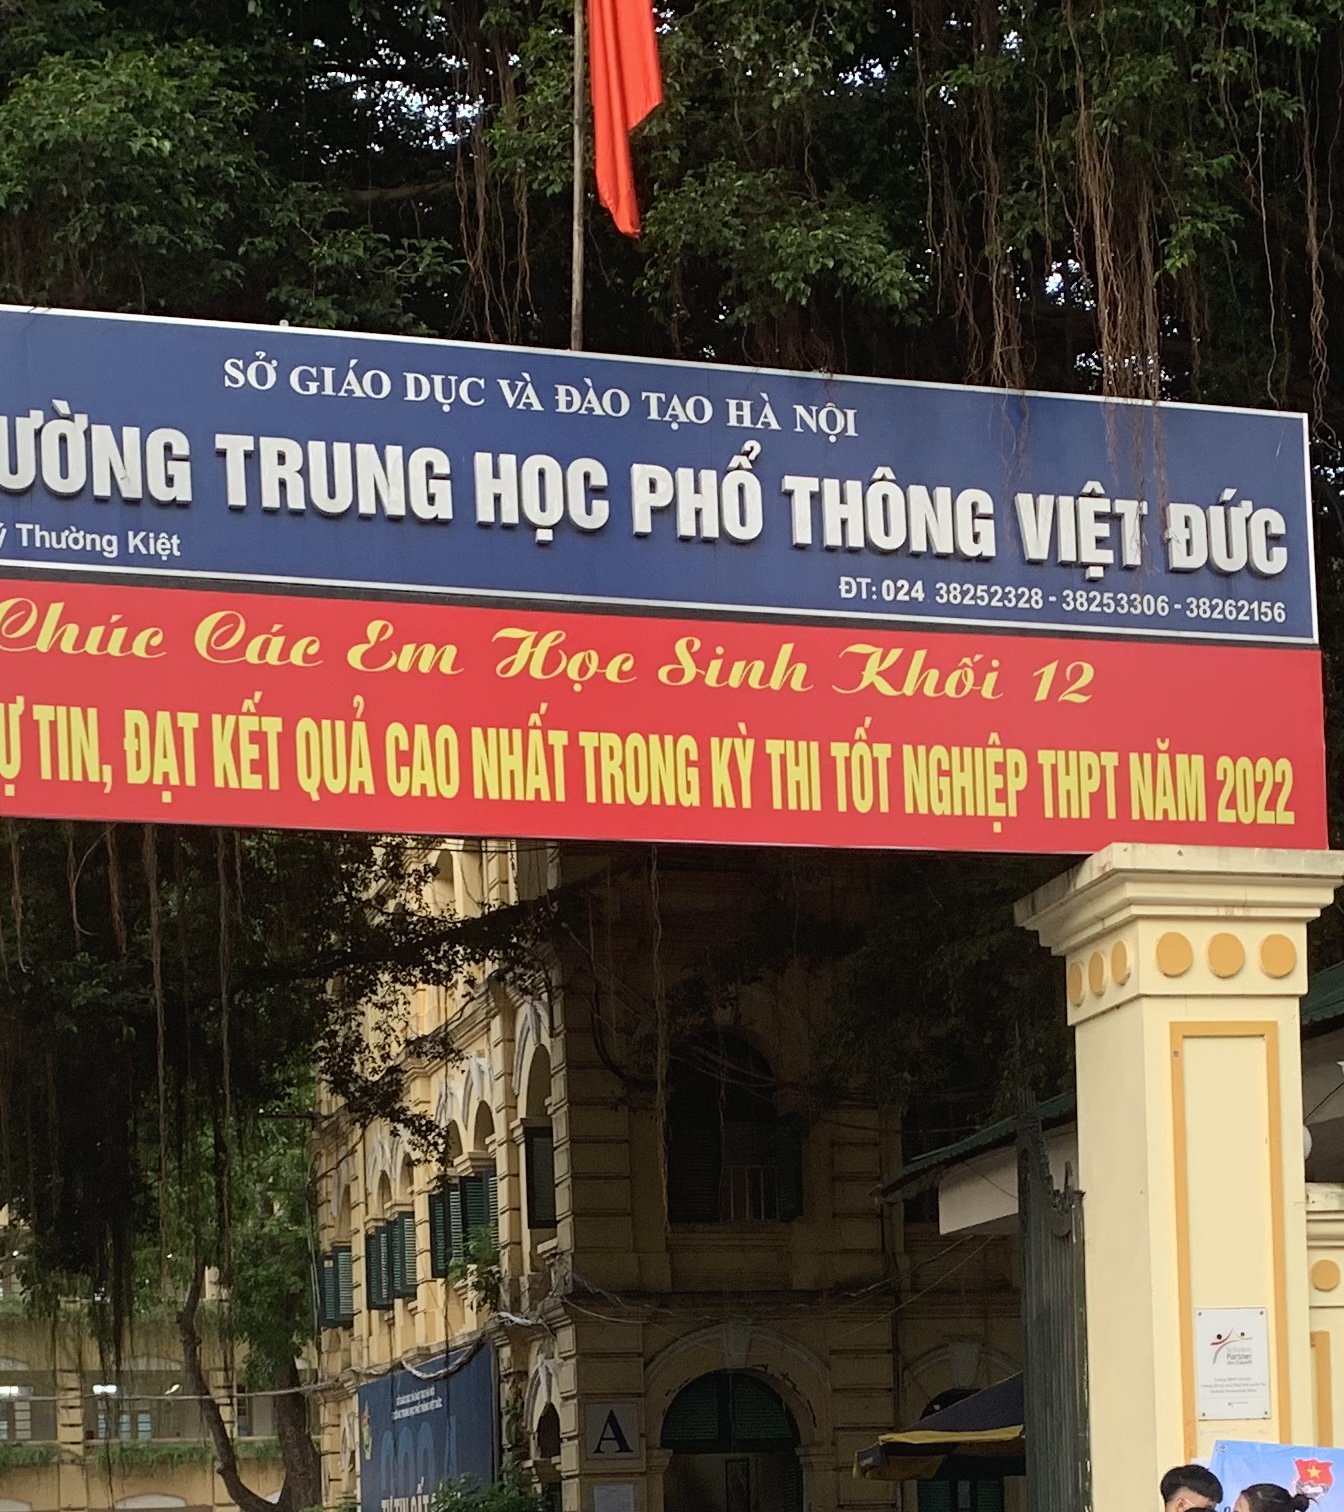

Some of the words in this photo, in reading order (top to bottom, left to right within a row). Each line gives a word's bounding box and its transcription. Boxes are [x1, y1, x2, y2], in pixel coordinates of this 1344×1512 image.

[224, 351, 279, 391] SỞ
[290, 358, 391, 401] GIÁO
[404, 375, 486, 413] DỤC
[497, 371, 544, 411] VÀ
[555, 378, 630, 417] ĐÀO
[647, 392, 713, 431] TẠO
[727, 392, 782, 432] HÀ
[794, 402, 859, 442] NỘI
[16, 520, 119, 559] Thường
[127, 529, 182, 560] Kiệt
[216, 432, 453, 521] TRUNG
[474, 452, 609, 545] HỌC
[630, 439, 765, 544] PHỔ
[782, 466, 996, 561] THÔNG
[1016, 480, 1149, 581] VIỆT
[1166, 487, 1288, 576] ĐỨC
[882, 579, 925, 603] 024
[936, 583, 1043, 610] 38252328
[1062, 589, 1169, 619] 38253306
[1185, 595, 1287, 624] 38262156
[195, 611, 323, 668] Các
[347, 619, 463, 676] Em
[491, 627, 637, 692] Học
[657, 635, 815, 693] Sinh
[831, 642, 1004, 702] Khối
[1033, 659, 1095, 704] 12
[32, 704, 114, 793] TIN,
[124, 708, 201, 803] ĐẠT
[211, 690, 283, 792] KẾT
[296, 694, 376, 802] QUẢ
[385, 723, 460, 800] CAO
[471, 701, 569, 803] NHẤT
[580, 730, 699, 807] TRONG
[710, 721, 756, 809] KỲ
[766, 738, 822, 813] THI
[830, 716, 894, 814] TỐT
[902, 732, 1028, 833] NGHIỆP
[1038, 747, 1119, 821] THPT
[1129, 737, 1207, 822] NĂM
[1217, 757, 1296, 826] 2022
[592, 1409, 634, 1454] A
